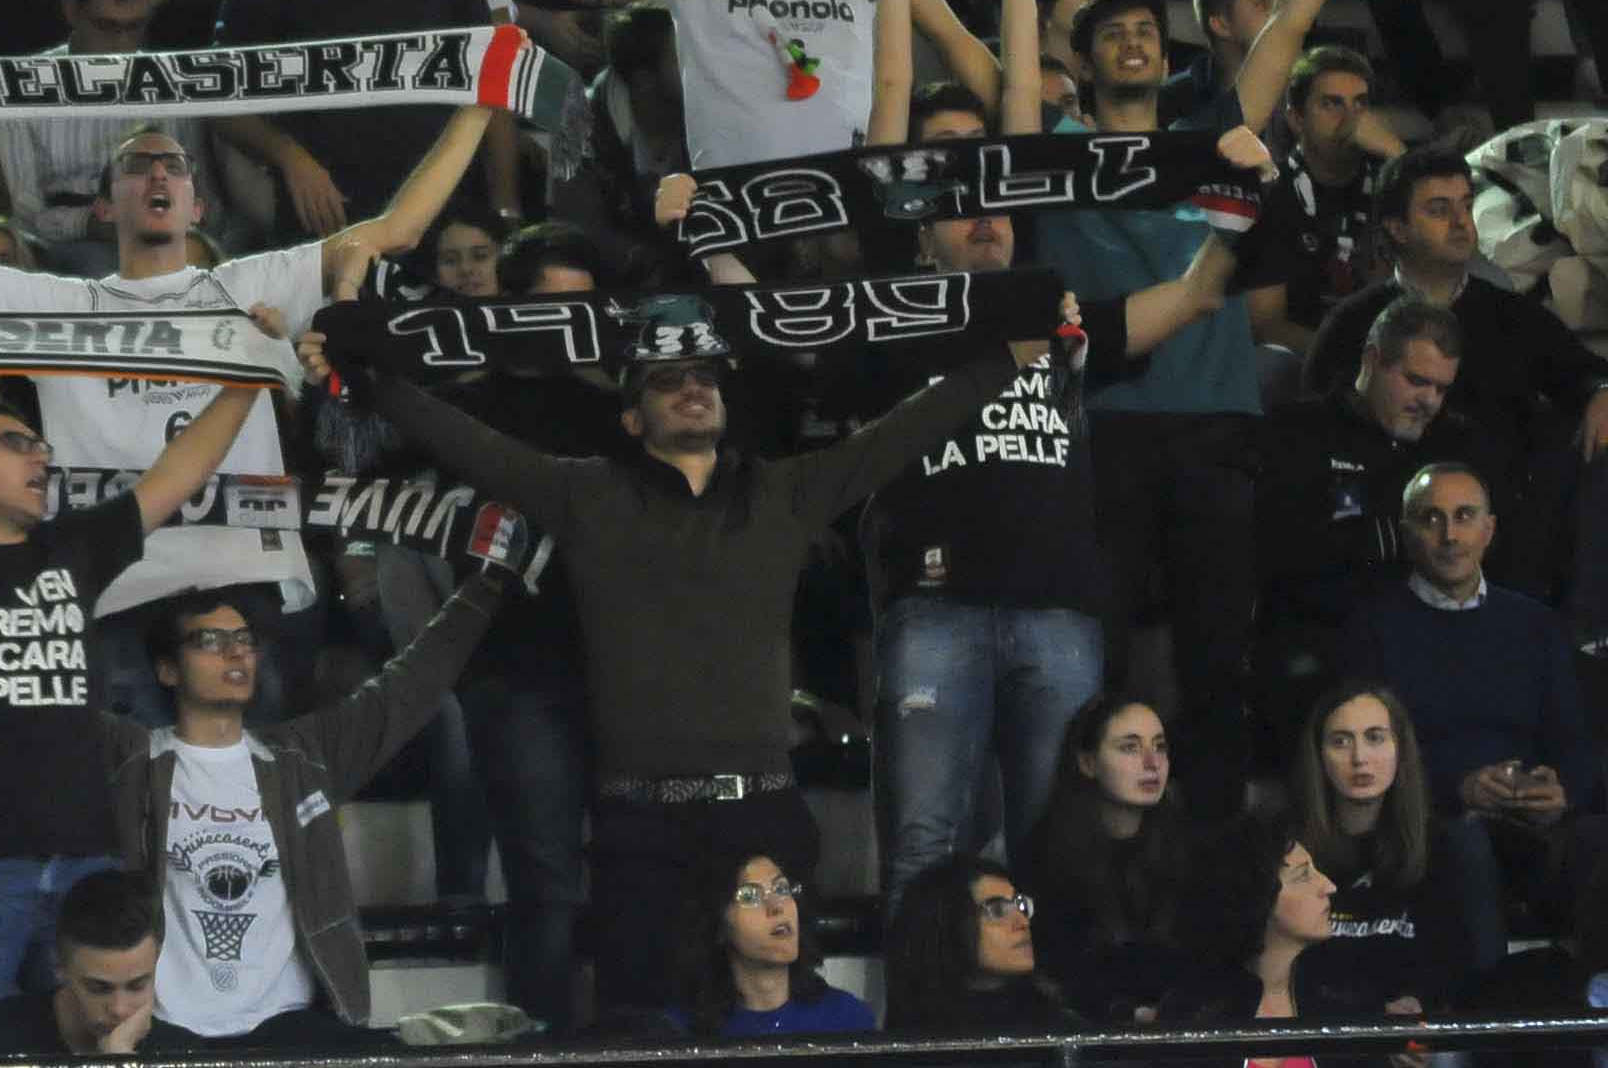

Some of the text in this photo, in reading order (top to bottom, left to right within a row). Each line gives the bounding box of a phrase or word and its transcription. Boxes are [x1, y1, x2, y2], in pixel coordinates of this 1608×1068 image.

[981, 402, 1070, 435] CARA
[923, 434, 1070, 476] LA PELLE
[14, 568, 79, 607] VEN
